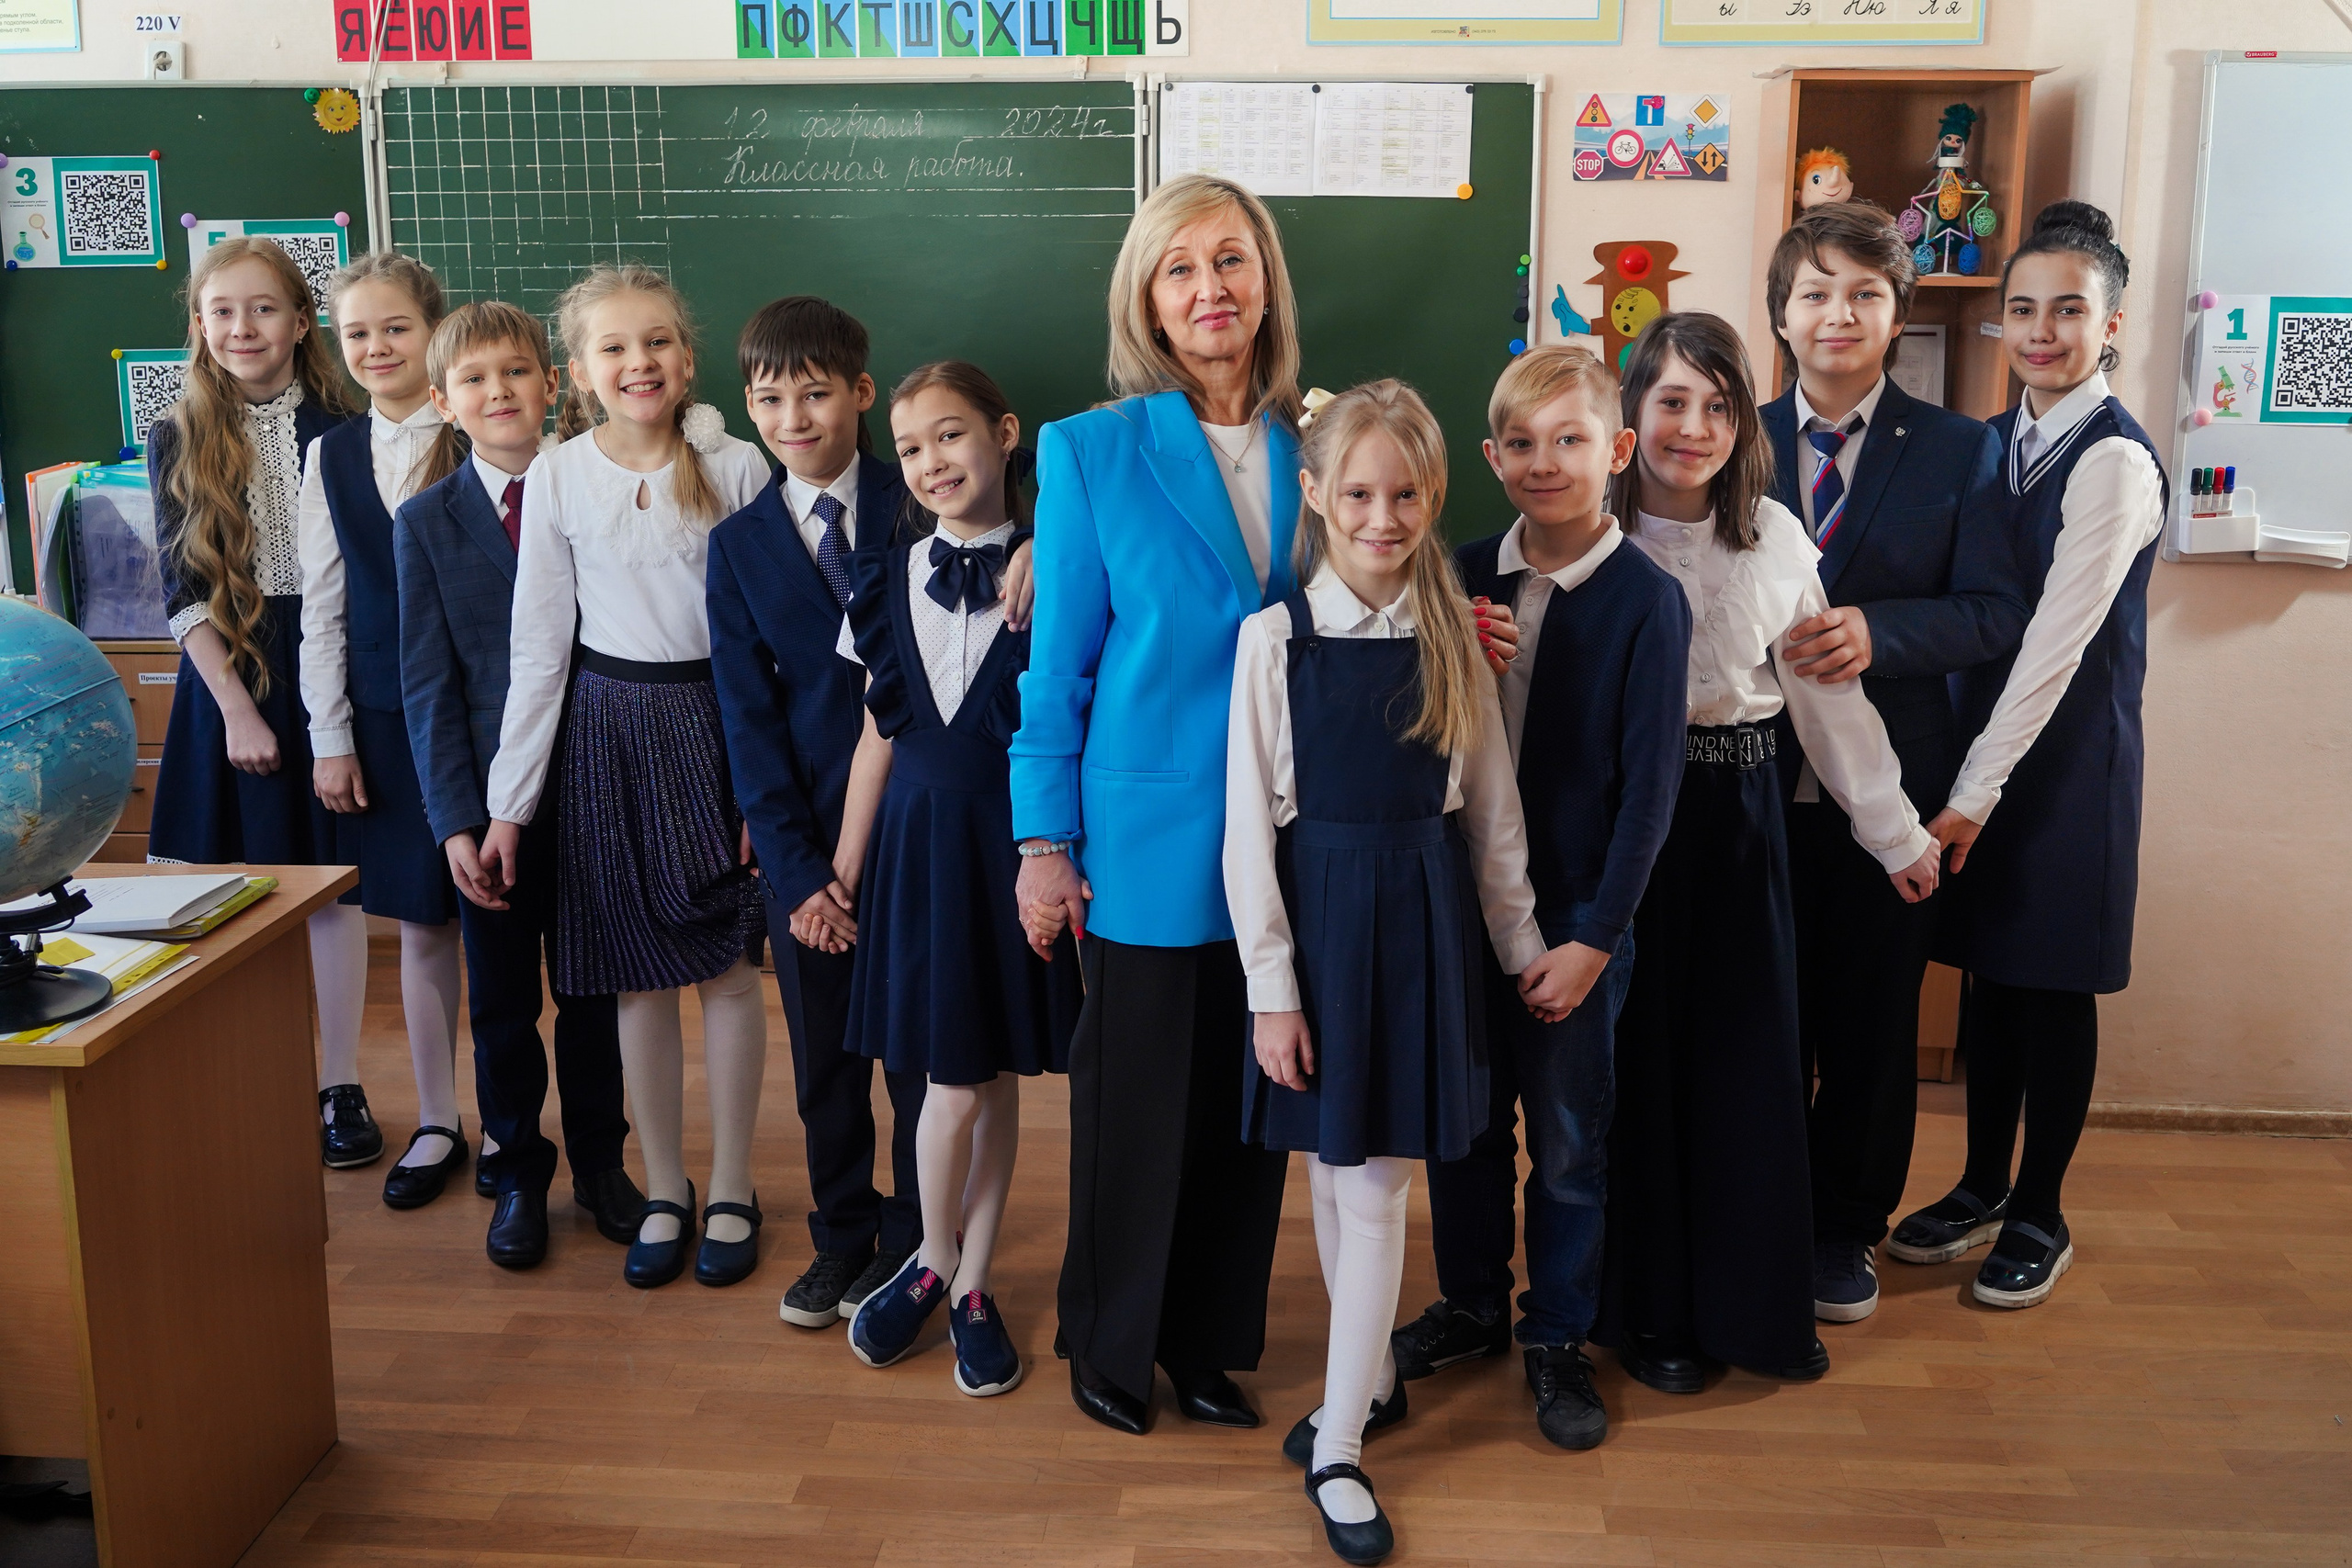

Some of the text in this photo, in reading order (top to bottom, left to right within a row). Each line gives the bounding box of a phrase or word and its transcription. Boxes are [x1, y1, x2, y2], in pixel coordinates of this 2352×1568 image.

[1718, 3, 1737, 16] ы
[135, 16, 181, 31] 220 V
[724, 107, 771, 139] 12
[801, 103, 928, 157] февраля
[721, 139, 1023, 188] Классная работа.
[1577, 159, 1600, 171] STOP
[16, 167, 39, 197] 3
[2226, 309, 2247, 340] 1
[141, 674, 167, 682] Проекты
